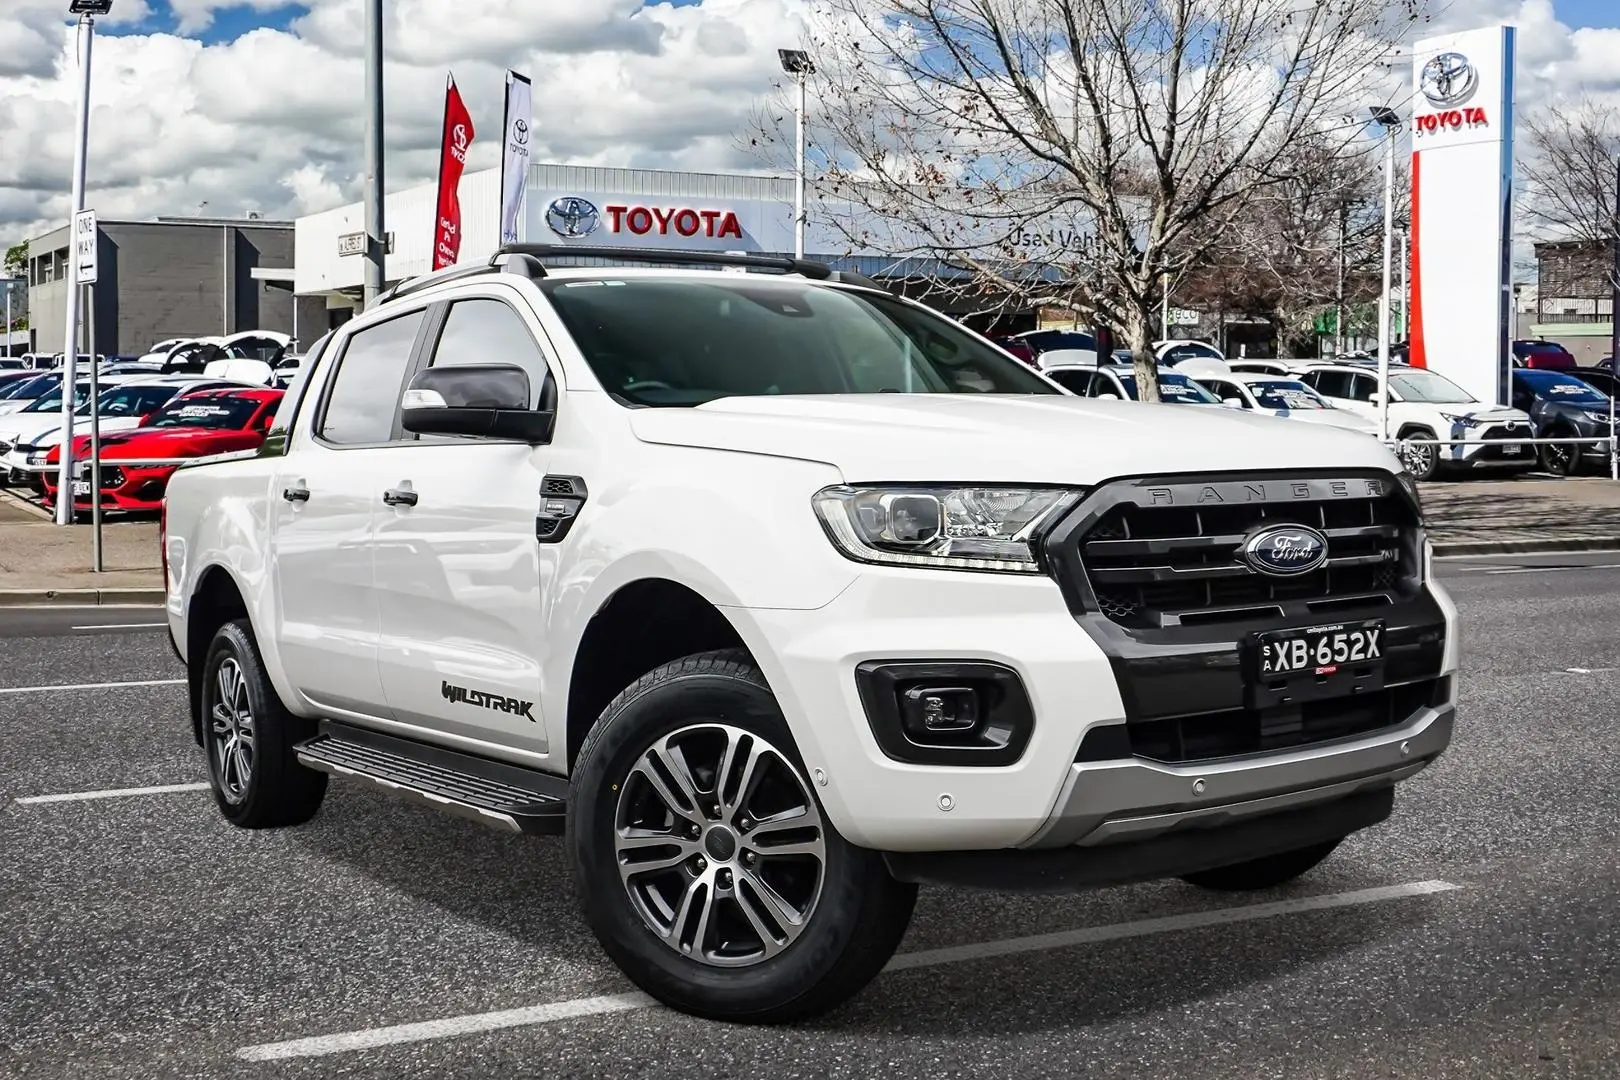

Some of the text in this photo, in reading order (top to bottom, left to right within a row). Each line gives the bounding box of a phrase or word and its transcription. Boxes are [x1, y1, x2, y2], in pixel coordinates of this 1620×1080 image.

[1415, 107, 1488, 131] TOYOTA
[78, 216, 93, 235] ONE
[606, 205, 743, 239] TOYOTA
[78, 239, 94, 256] WAY
[1008, 228, 1054, 247] Used
[1147, 480, 1384, 505] RANGER
[1271, 535, 1313, 562] Ford
[441, 680, 537, 723] WILDTRAK
